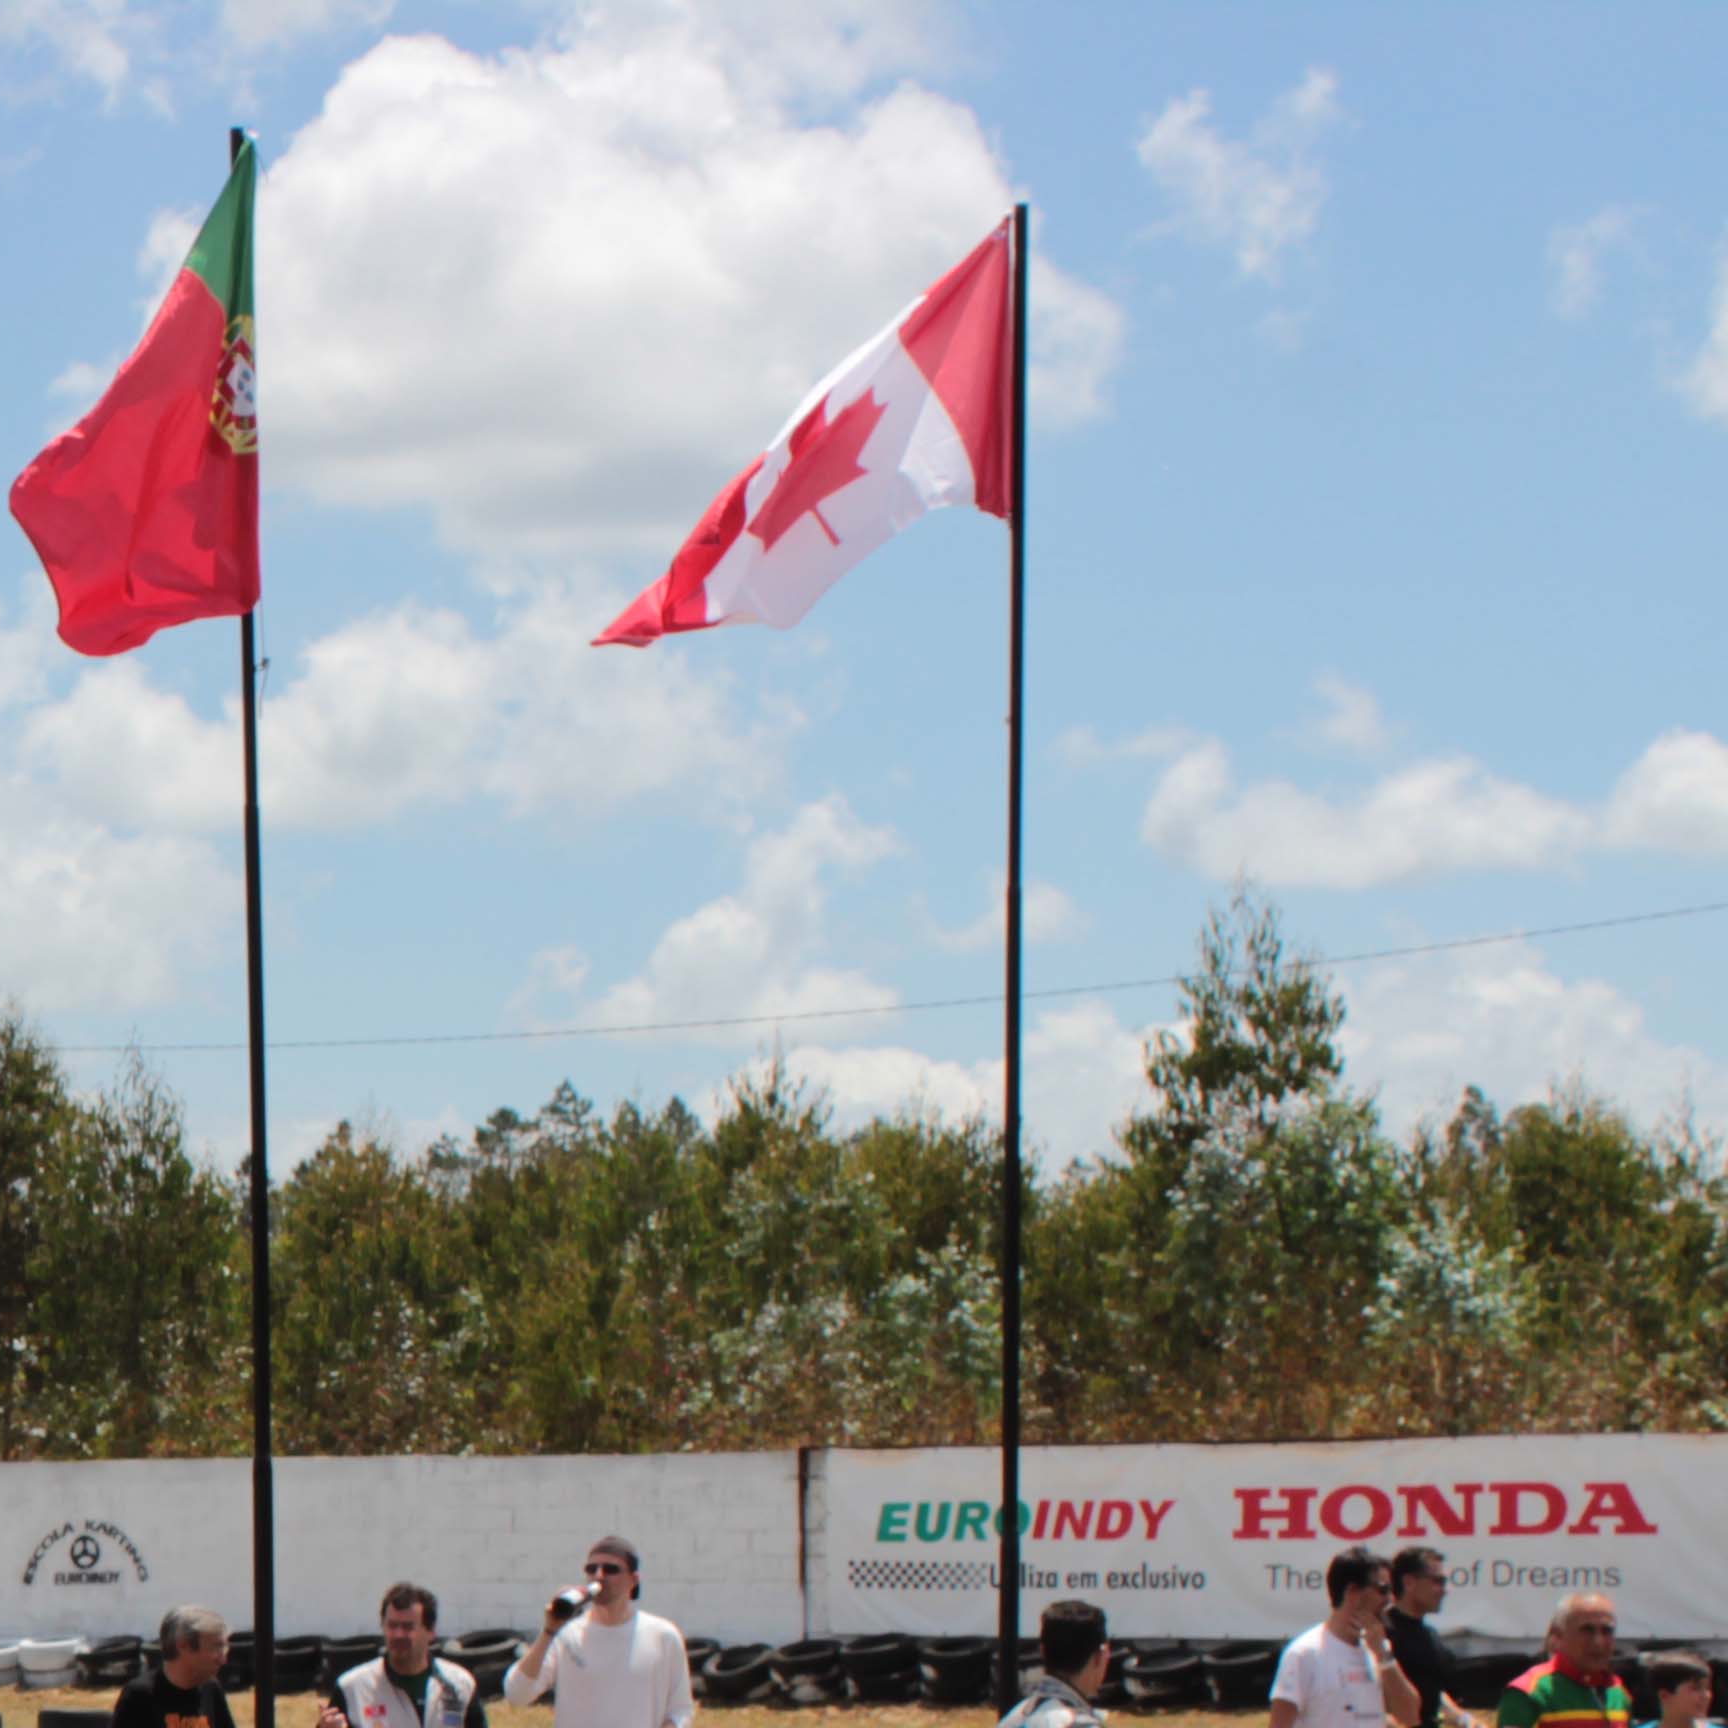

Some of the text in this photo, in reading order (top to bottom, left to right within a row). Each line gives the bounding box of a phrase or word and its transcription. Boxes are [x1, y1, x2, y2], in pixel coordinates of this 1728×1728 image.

[1233, 1482, 1658, 1540] HONDA
[988, 1562, 1206, 1590] Uliza em exclusivo
[1266, 1560, 1622, 1590] The of Dreams
